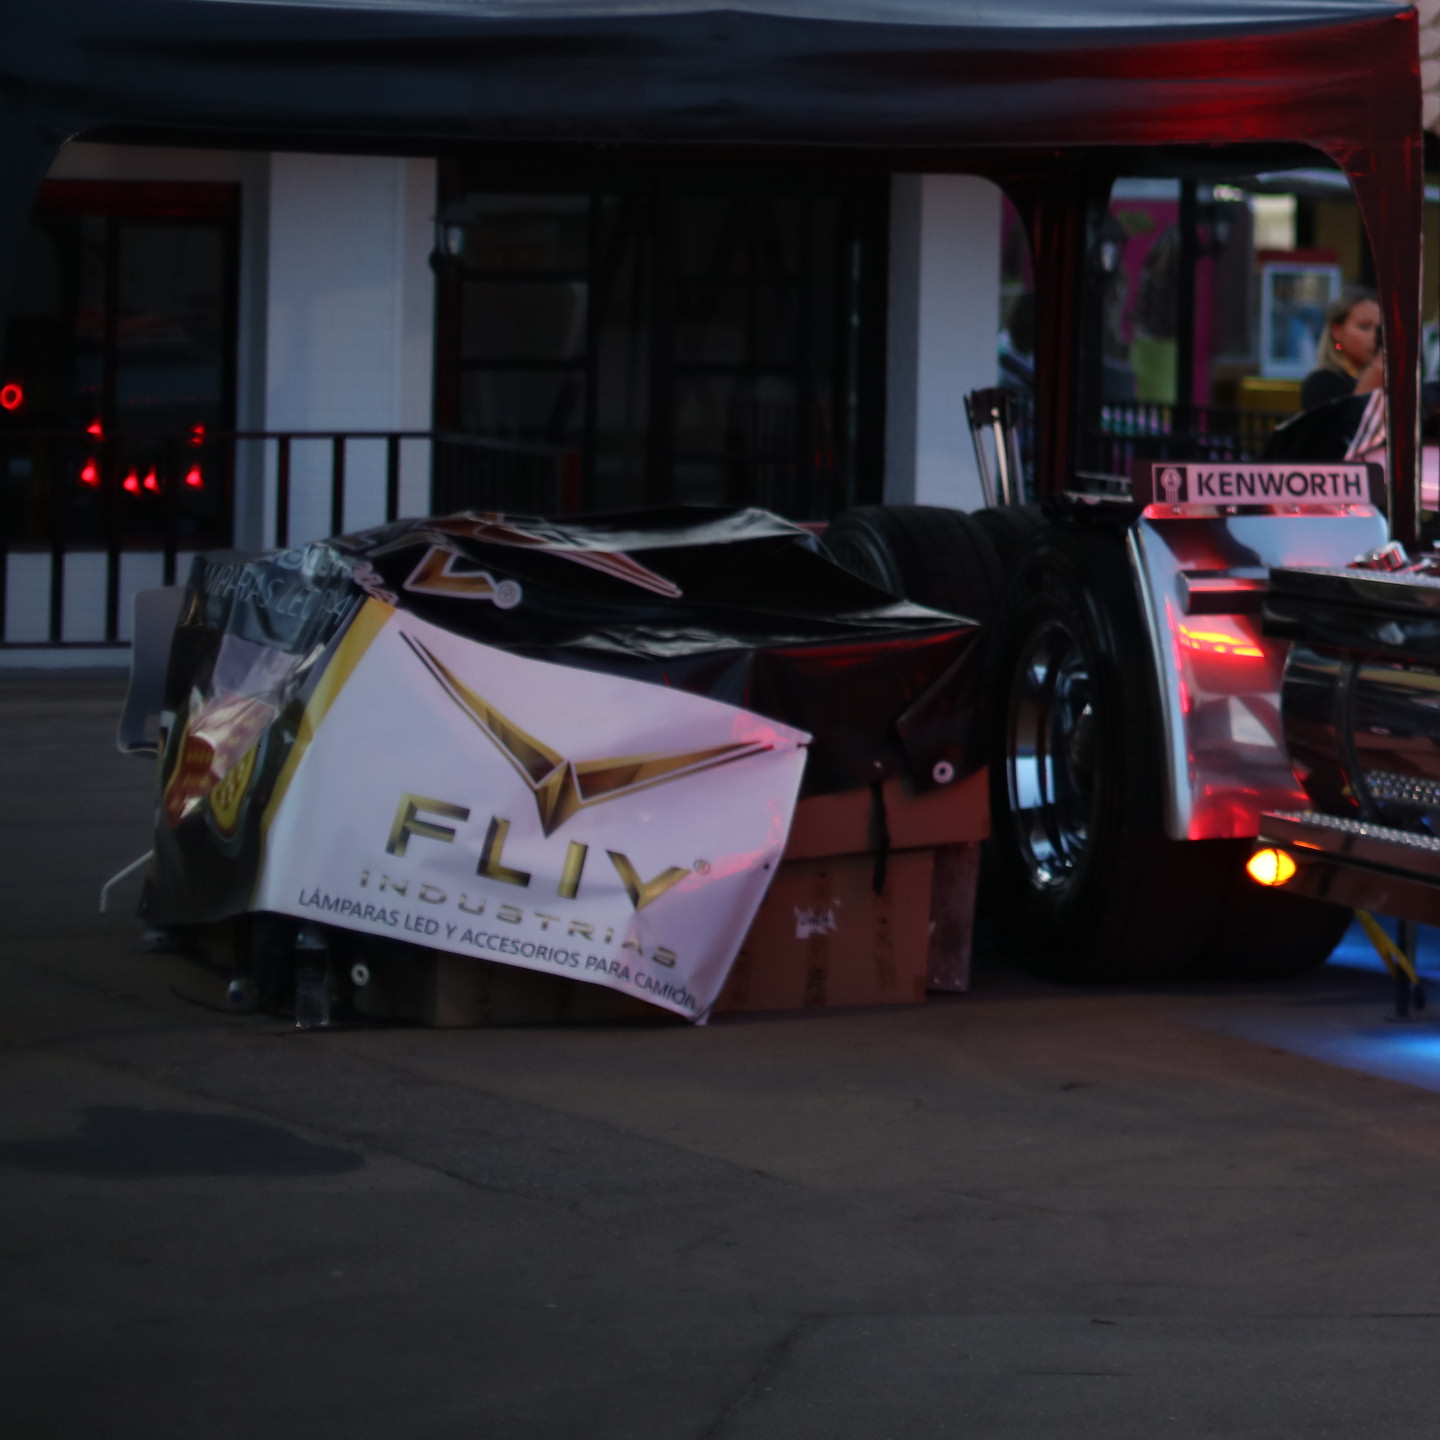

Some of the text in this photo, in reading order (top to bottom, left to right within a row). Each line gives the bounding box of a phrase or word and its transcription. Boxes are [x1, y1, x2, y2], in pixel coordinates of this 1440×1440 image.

[1196, 471, 1362, 497] KENWORTH
[297, 887, 698, 1010] LÁMPARAS LED Y ACCESORIOS PARA CAMIÓN
[358, 869, 680, 969] INDUSTRIAS
